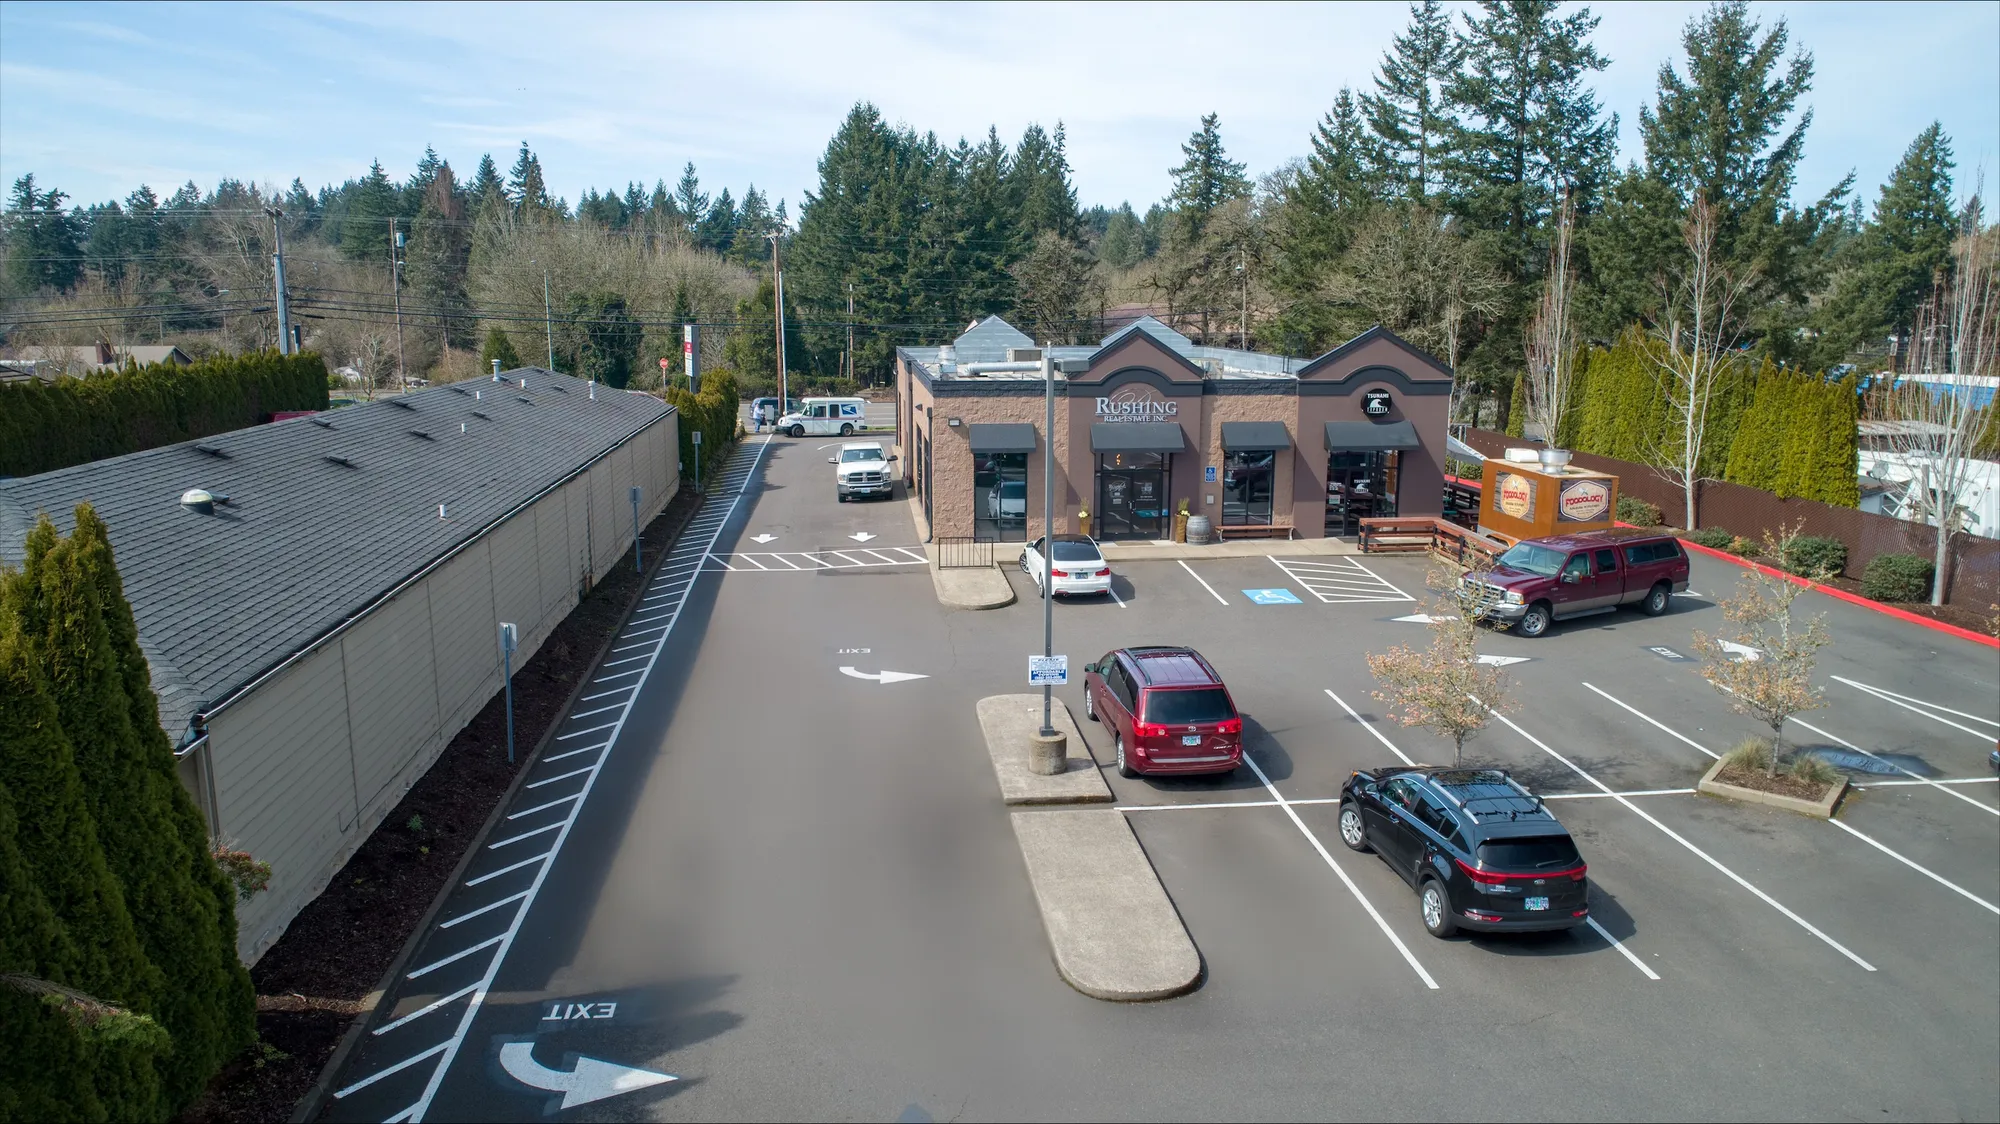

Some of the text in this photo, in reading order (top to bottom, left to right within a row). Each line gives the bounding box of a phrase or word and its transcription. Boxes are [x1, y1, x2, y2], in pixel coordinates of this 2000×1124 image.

[1095, 397, 1177, 414] RUSHING
[1565, 494, 1604, 507] FOODOLOGY
[1650, 647, 1684, 658] EXIT
[541, 1002, 617, 1020] EXIT
